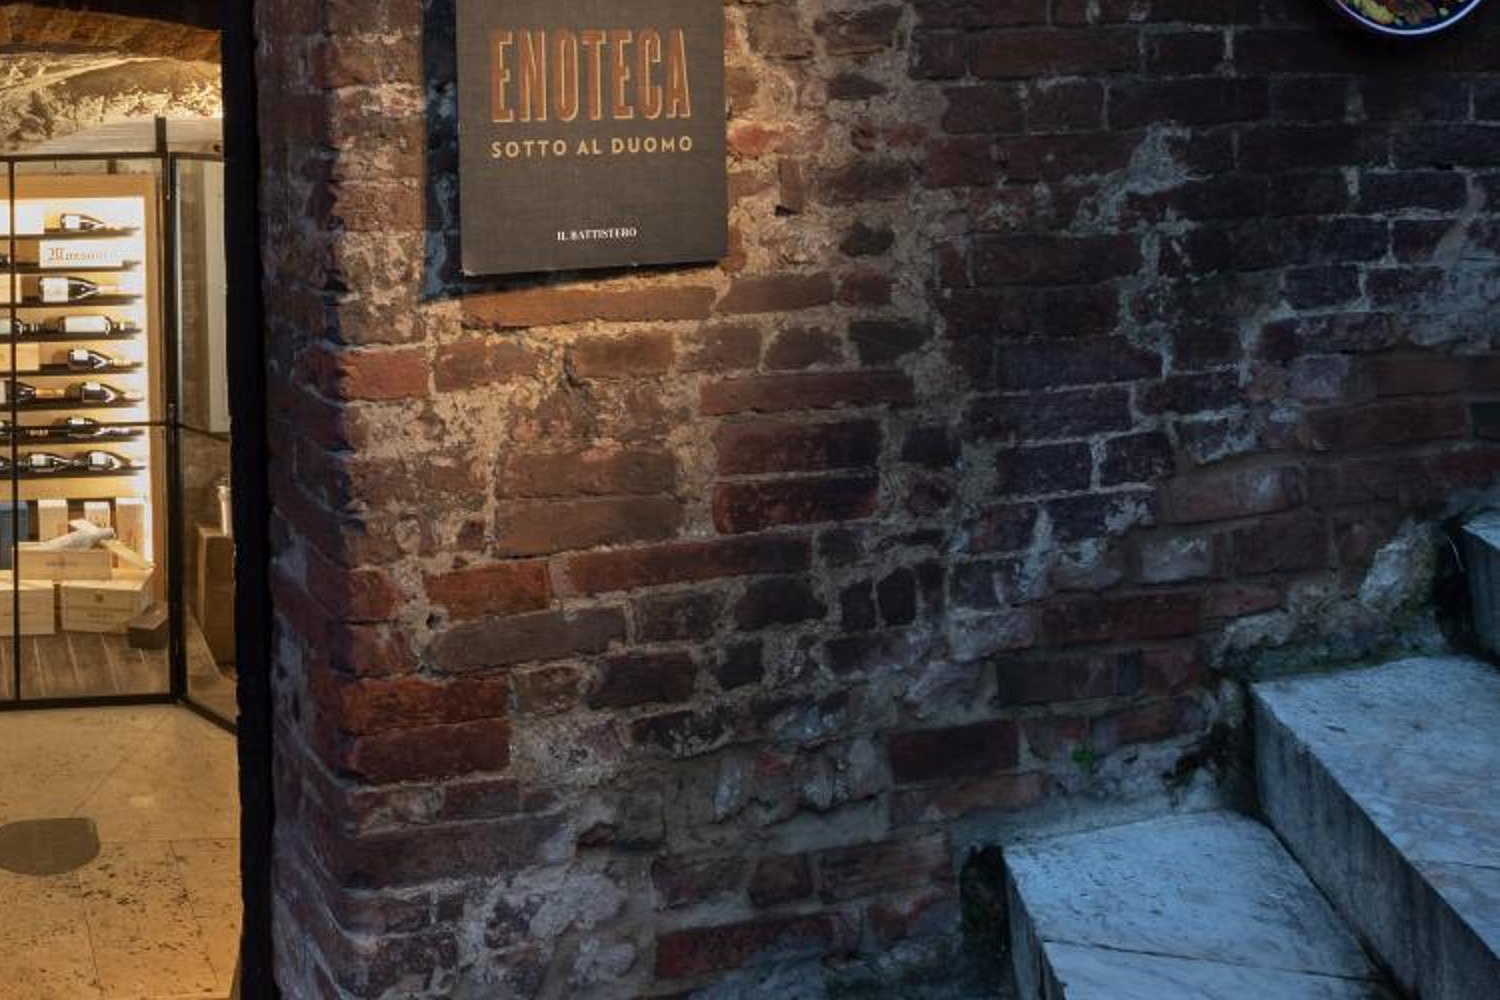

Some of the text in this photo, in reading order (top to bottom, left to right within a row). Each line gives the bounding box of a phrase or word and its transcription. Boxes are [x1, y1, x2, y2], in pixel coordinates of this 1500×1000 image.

[490, 26, 692, 123] ENOTECA
[491, 135, 693, 159] SOTTO AL DUOMO
[556, 227, 637, 241] IL BATTISTERO
